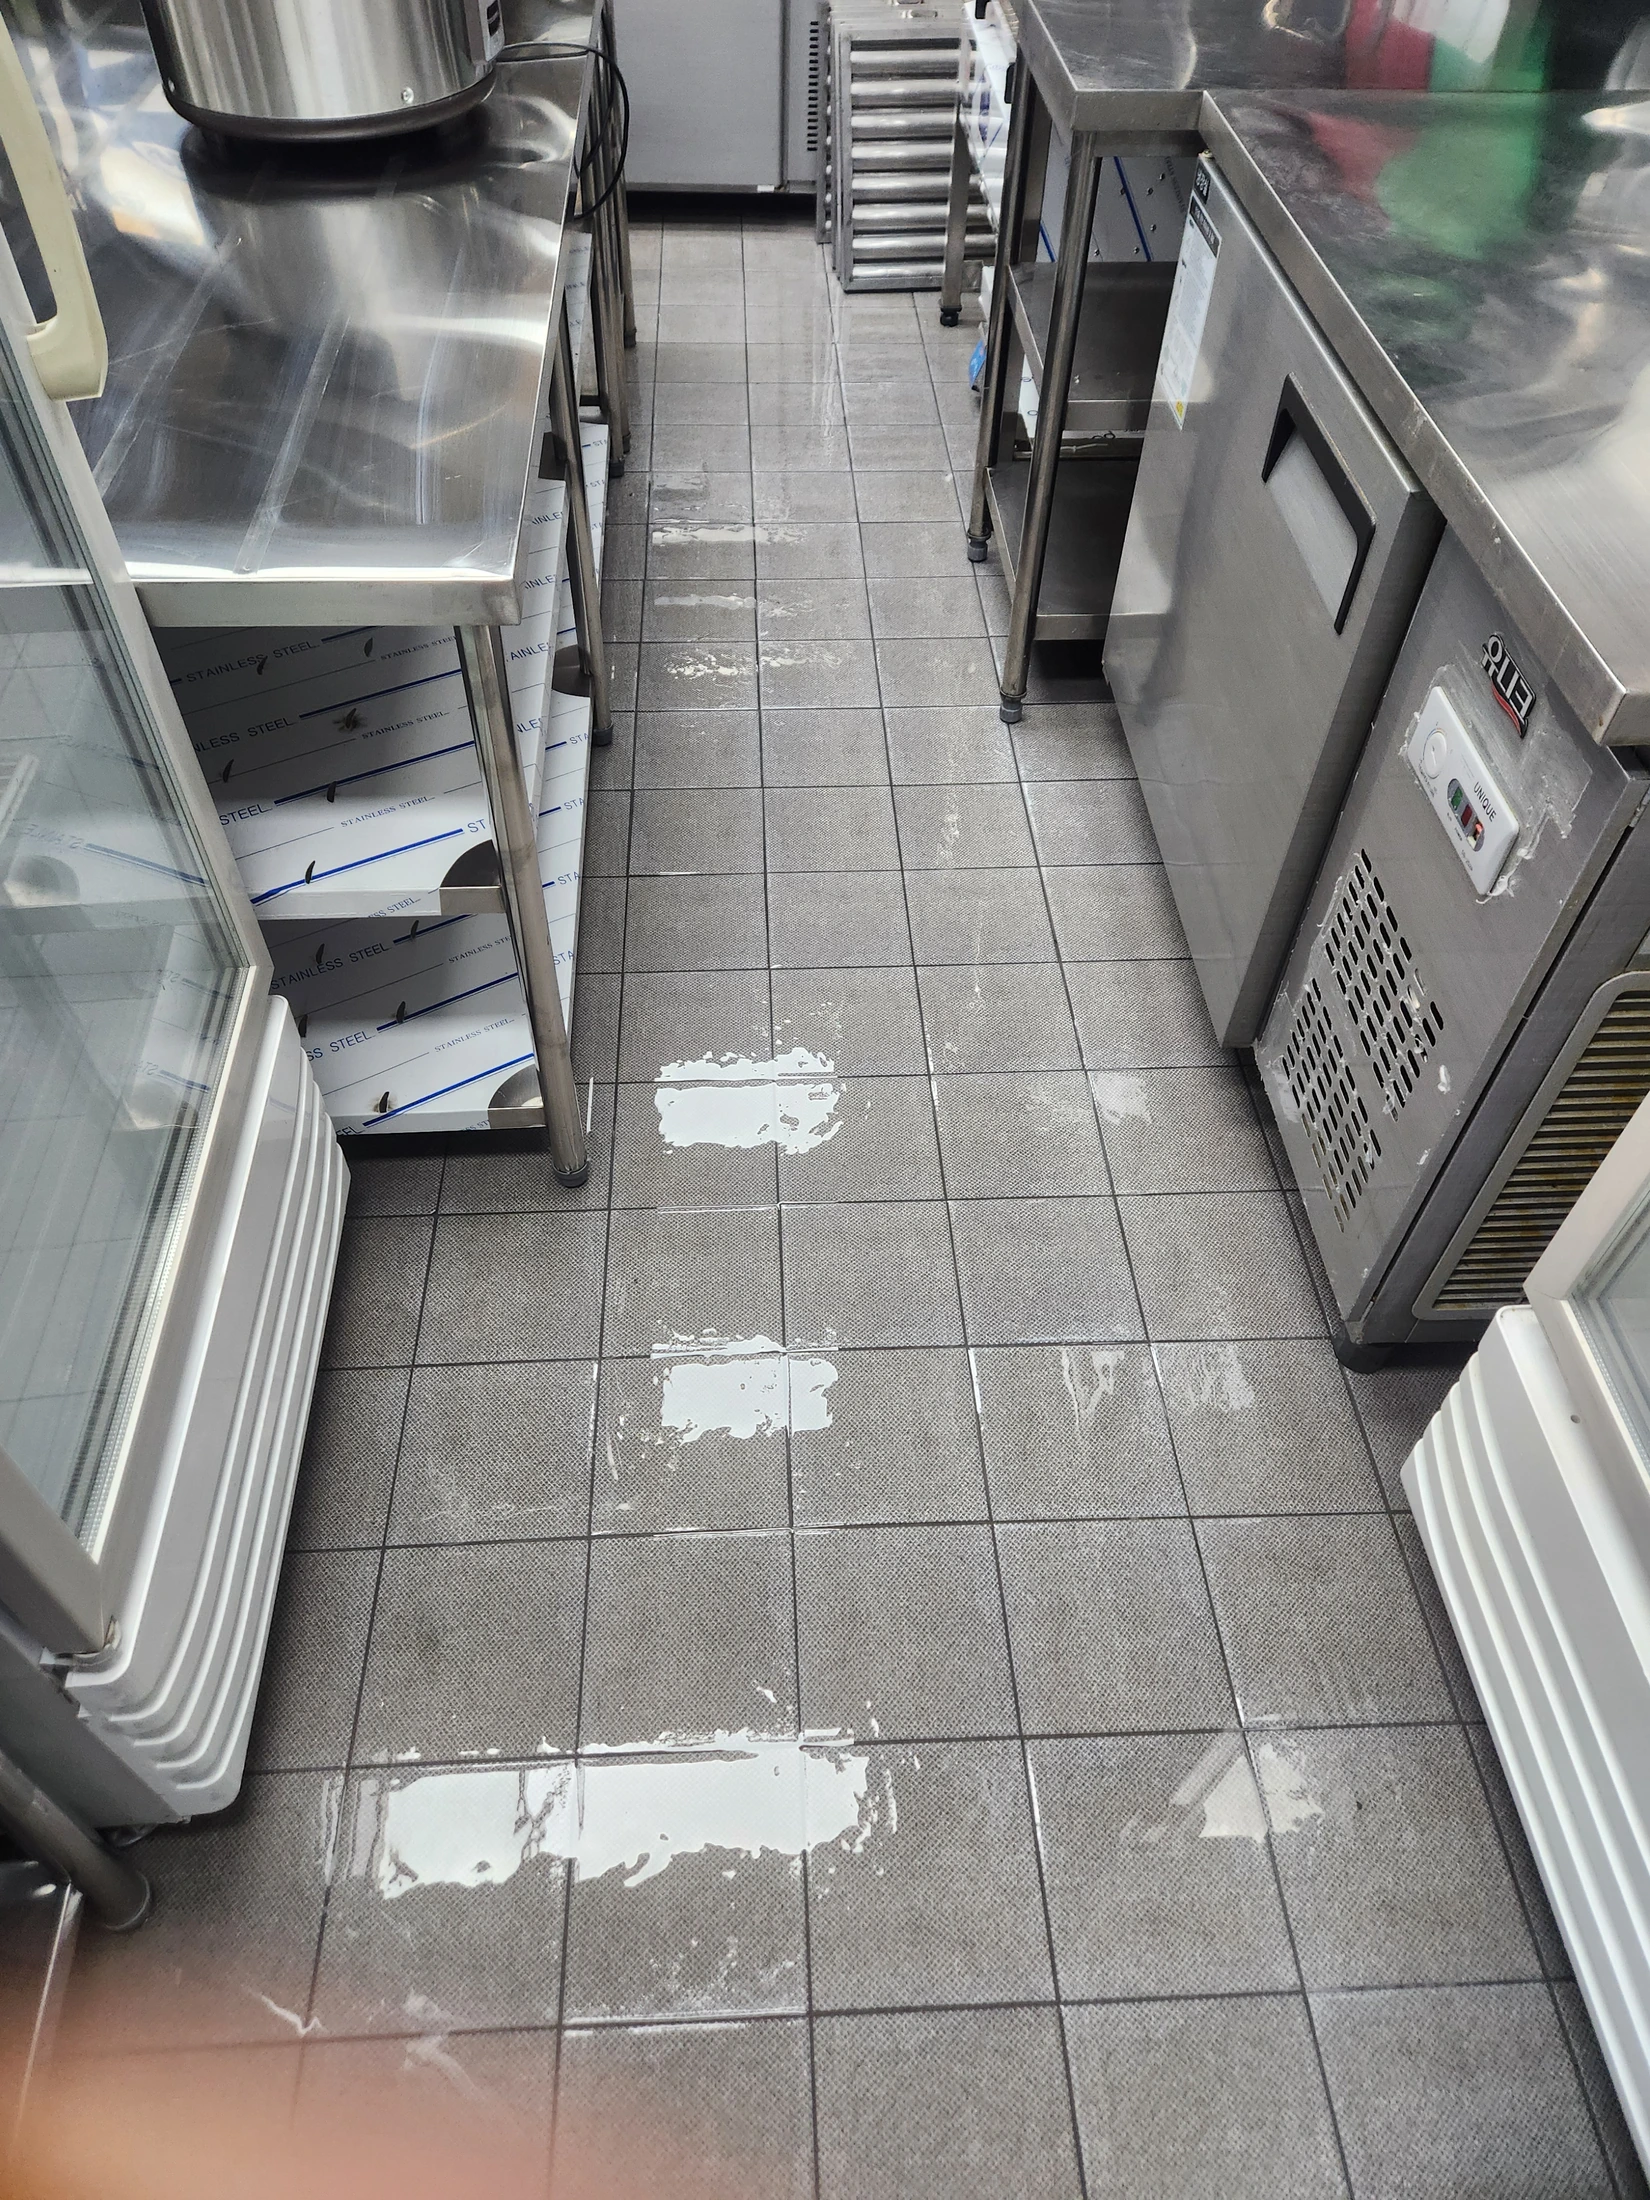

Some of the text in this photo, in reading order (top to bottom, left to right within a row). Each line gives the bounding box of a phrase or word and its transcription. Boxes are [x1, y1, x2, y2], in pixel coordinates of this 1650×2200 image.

[187, 641, 318, 683] STAINLESS STEEL
[380, 642, 430, 661] STAINLESS
[247, 717, 294, 737] STEEL
[361, 711, 447, 740] STAINLESS STEEL
[340, 796, 433, 828] STAINLESS STEEL
[1473, 781, 1497, 822] UNIQUE
[219, 804, 271, 826] STEEL
[467, 818, 486, 833] ST
[386, 897, 419, 914] STEEL
[448, 943, 493, 964] STAINLESS
[270, 942, 391, 990] STAINLESS STEEL
[329, 1030, 374, 1053] STEEL
[434, 1017, 512, 1053] STAINLESS STEEL
